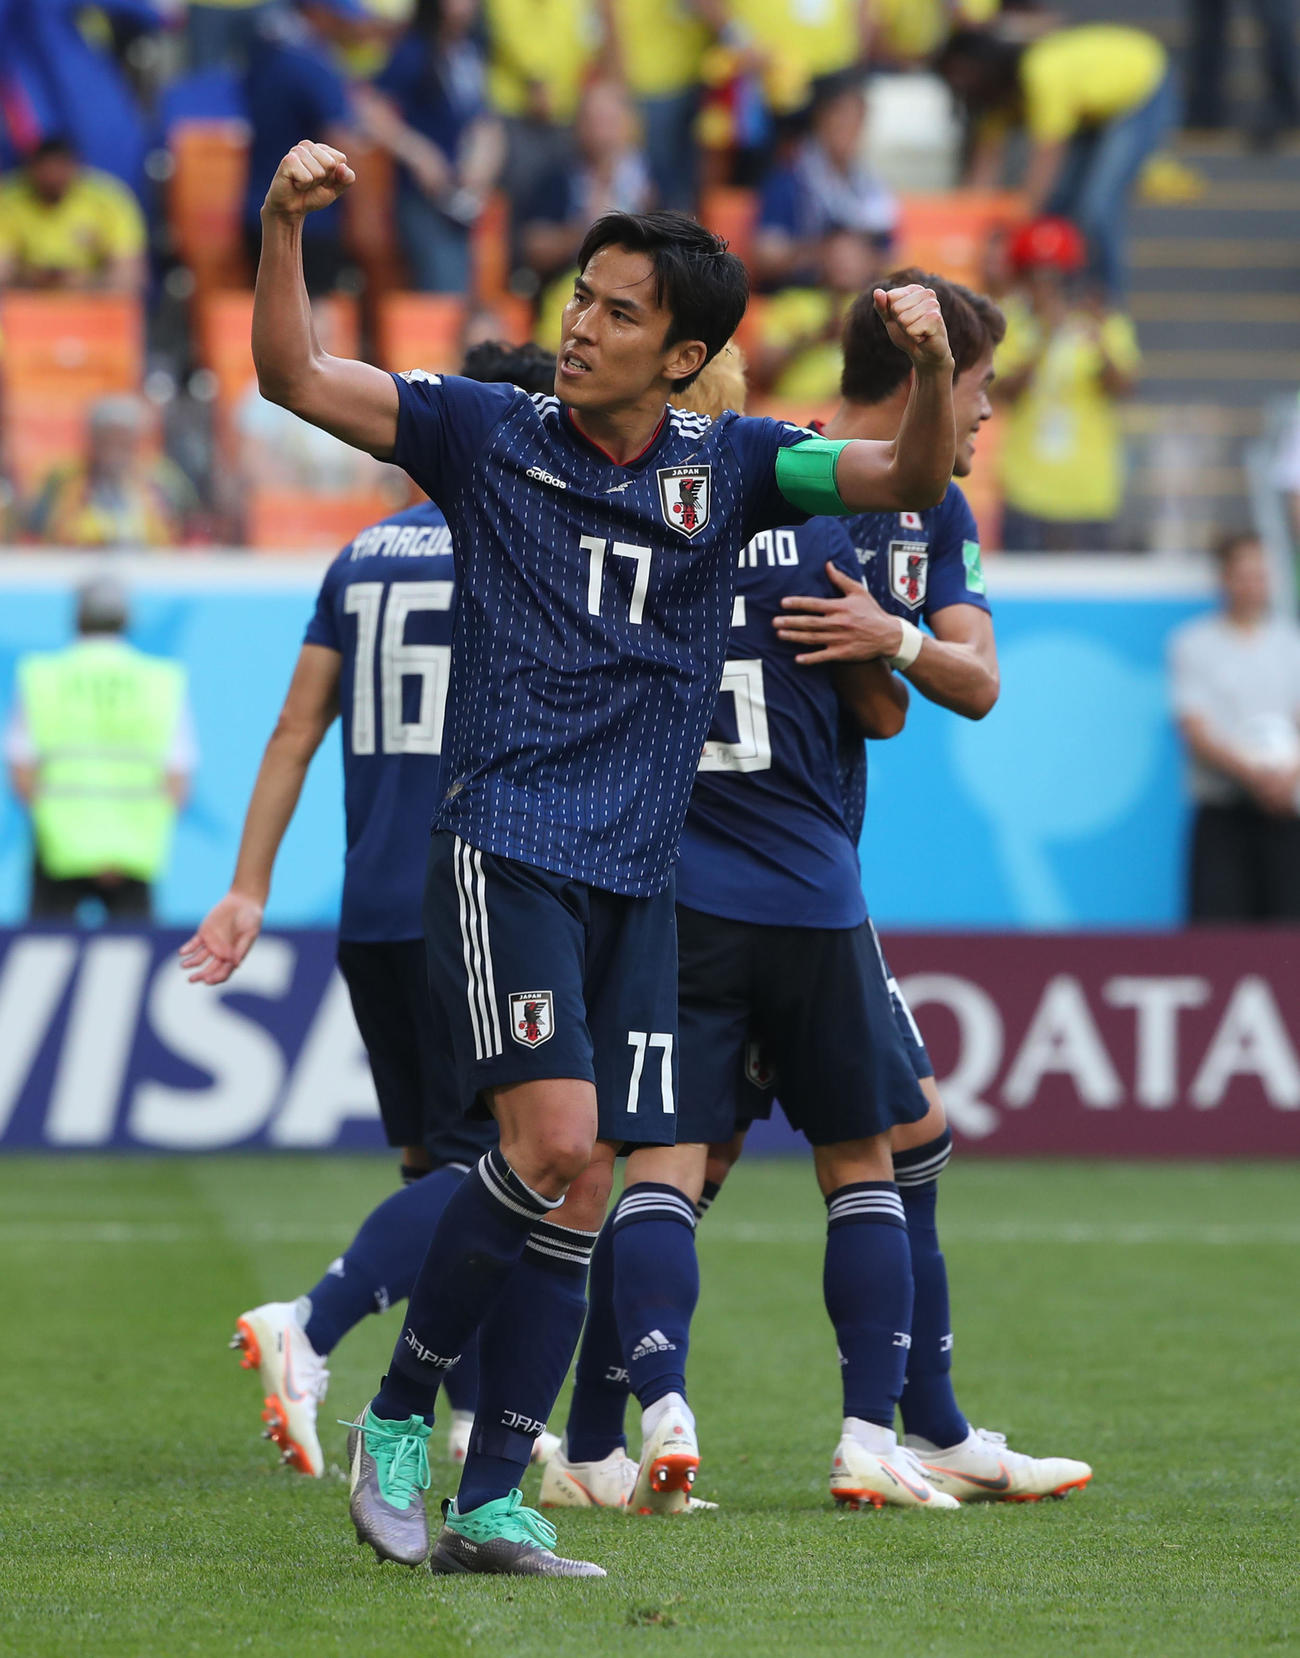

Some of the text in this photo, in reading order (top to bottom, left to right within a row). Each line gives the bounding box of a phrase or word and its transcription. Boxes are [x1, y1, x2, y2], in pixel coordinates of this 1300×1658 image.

[526, 466, 567, 489] adidas
[672, 468, 700, 476] JAPAN
[679, 514, 699, 525] JFA
[738, 527, 799, 569] MO
[579, 534, 652, 625] 17
[344, 581, 455, 757] 16
[519, 993, 542, 1001] JAPAN
[522, 1029, 543, 1039] JFA
[626, 1031, 675, 1114] 17
